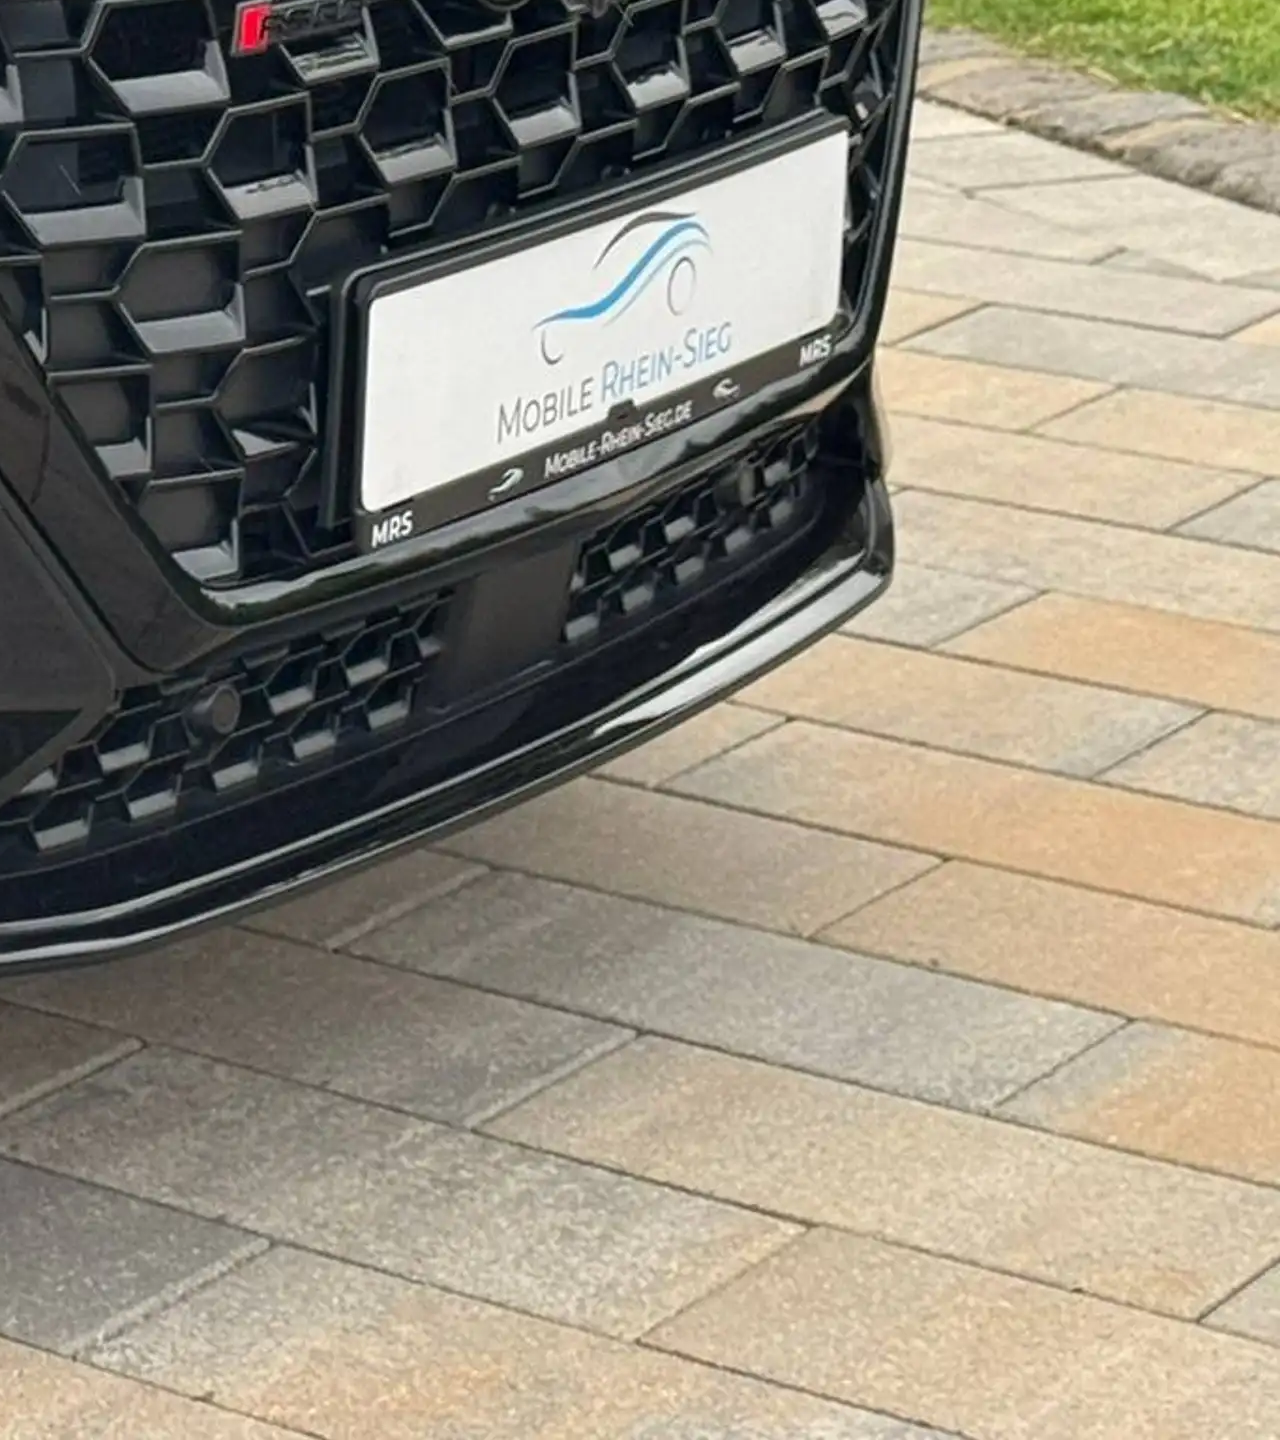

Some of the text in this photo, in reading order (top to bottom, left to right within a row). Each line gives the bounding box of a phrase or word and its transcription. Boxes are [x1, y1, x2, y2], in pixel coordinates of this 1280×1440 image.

[798, 333, 833, 368] MRS
[497, 320, 733, 444] MOBILE RHEIN-SIEG
[544, 399, 693, 480] MOBILE-RHEIN-SIEG.DE
[371, 510, 414, 549] MRS
